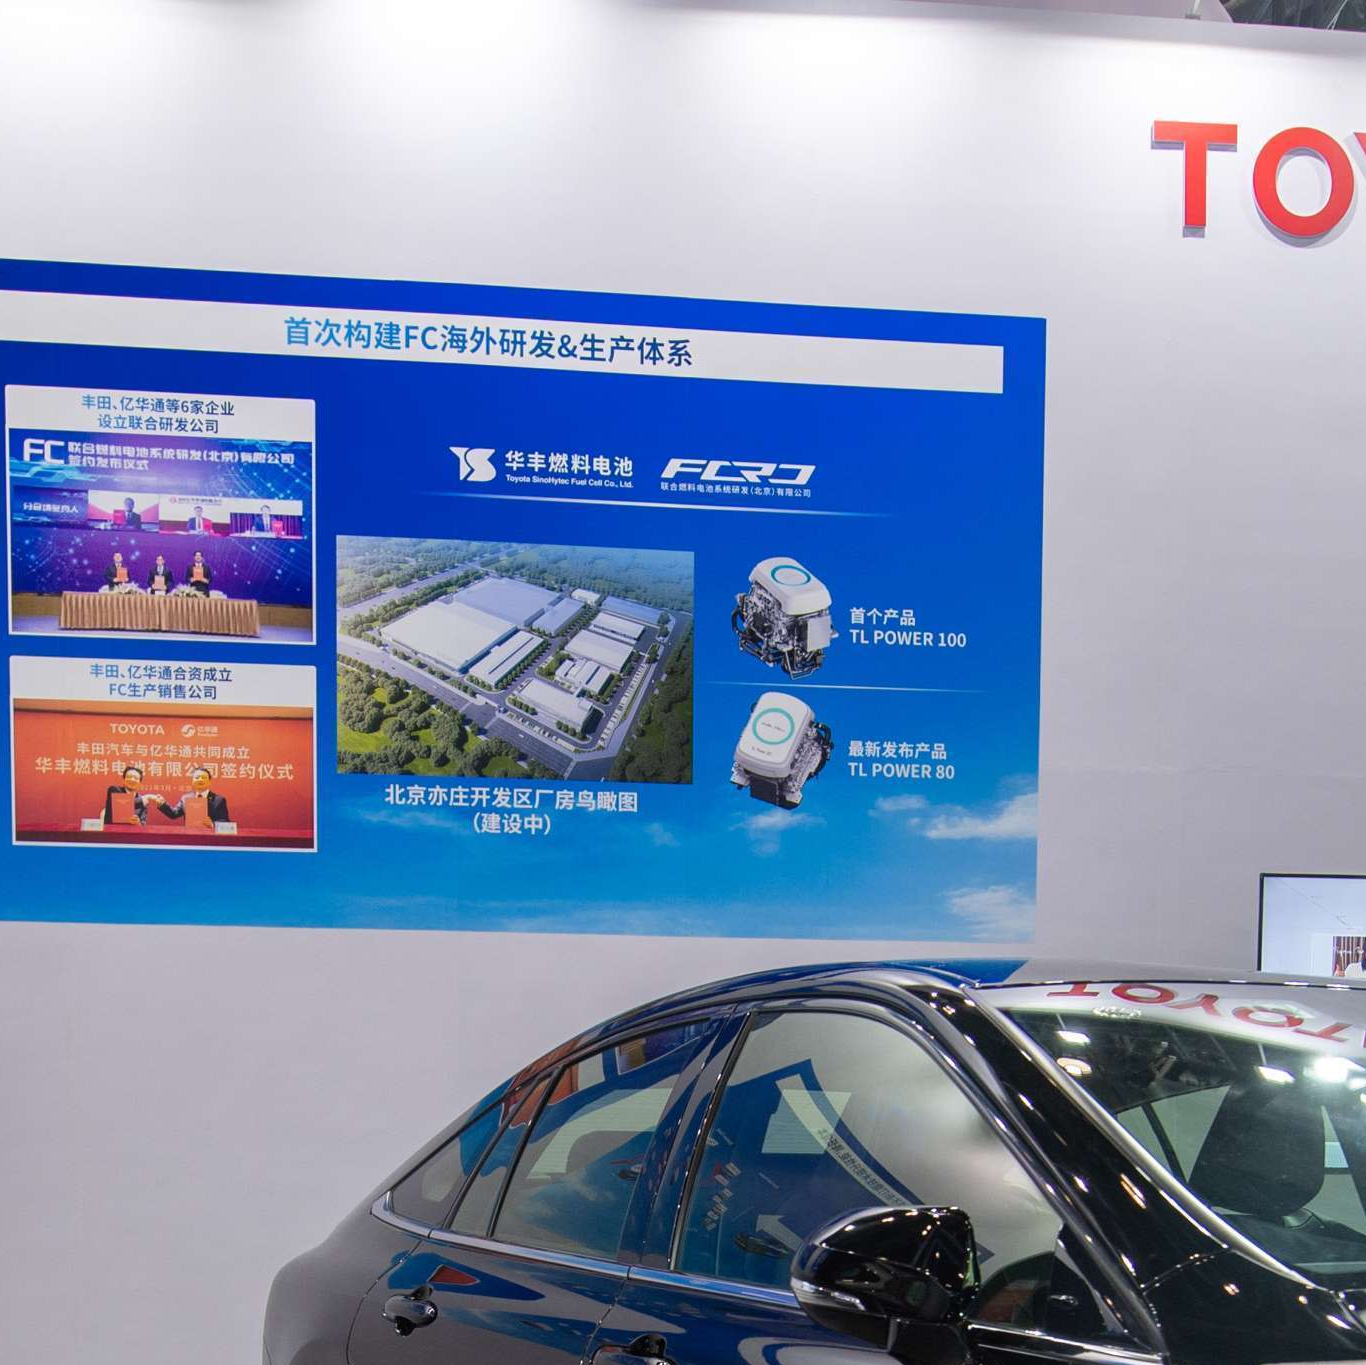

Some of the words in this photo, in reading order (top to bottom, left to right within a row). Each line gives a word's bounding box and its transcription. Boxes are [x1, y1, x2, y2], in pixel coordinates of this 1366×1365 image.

[284, 317, 693, 368] 首次构建FC海外研发&生产体系
[82, 394, 235, 416] 丰田、亿华通等6家企业
[98, 414, 219, 433] 设立联合研发公司
[23, 438, 64, 464] FC
[505, 450, 633, 477] 华丰燃料电池
[506, 474, 530, 483] Toyota
[571, 478, 587, 486] Fuel
[588, 479, 602, 487] Cell
[850, 607, 916, 626] 首个产品
[850, 629, 869, 644] TL
[874, 630, 933, 647] POWER
[938, 632, 966, 648] 100
[90, 664, 232, 682] 丰田、亿华通合资成立
[109, 683, 217, 699] FC生产销售公司
[110, 723, 165, 735] TOYOTA
[77, 742, 250, 759] 丰田汽车与亿华通共同成立
[848, 740, 947, 760] 最新发布产品
[848, 762, 867, 777] TL
[872, 763, 931, 779] POWER
[936, 765, 955, 780] 80
[384, 784, 639, 812] 北京亦庄开发区厂房鸟瞰图
[472, 812, 551, 835] (建设中)
